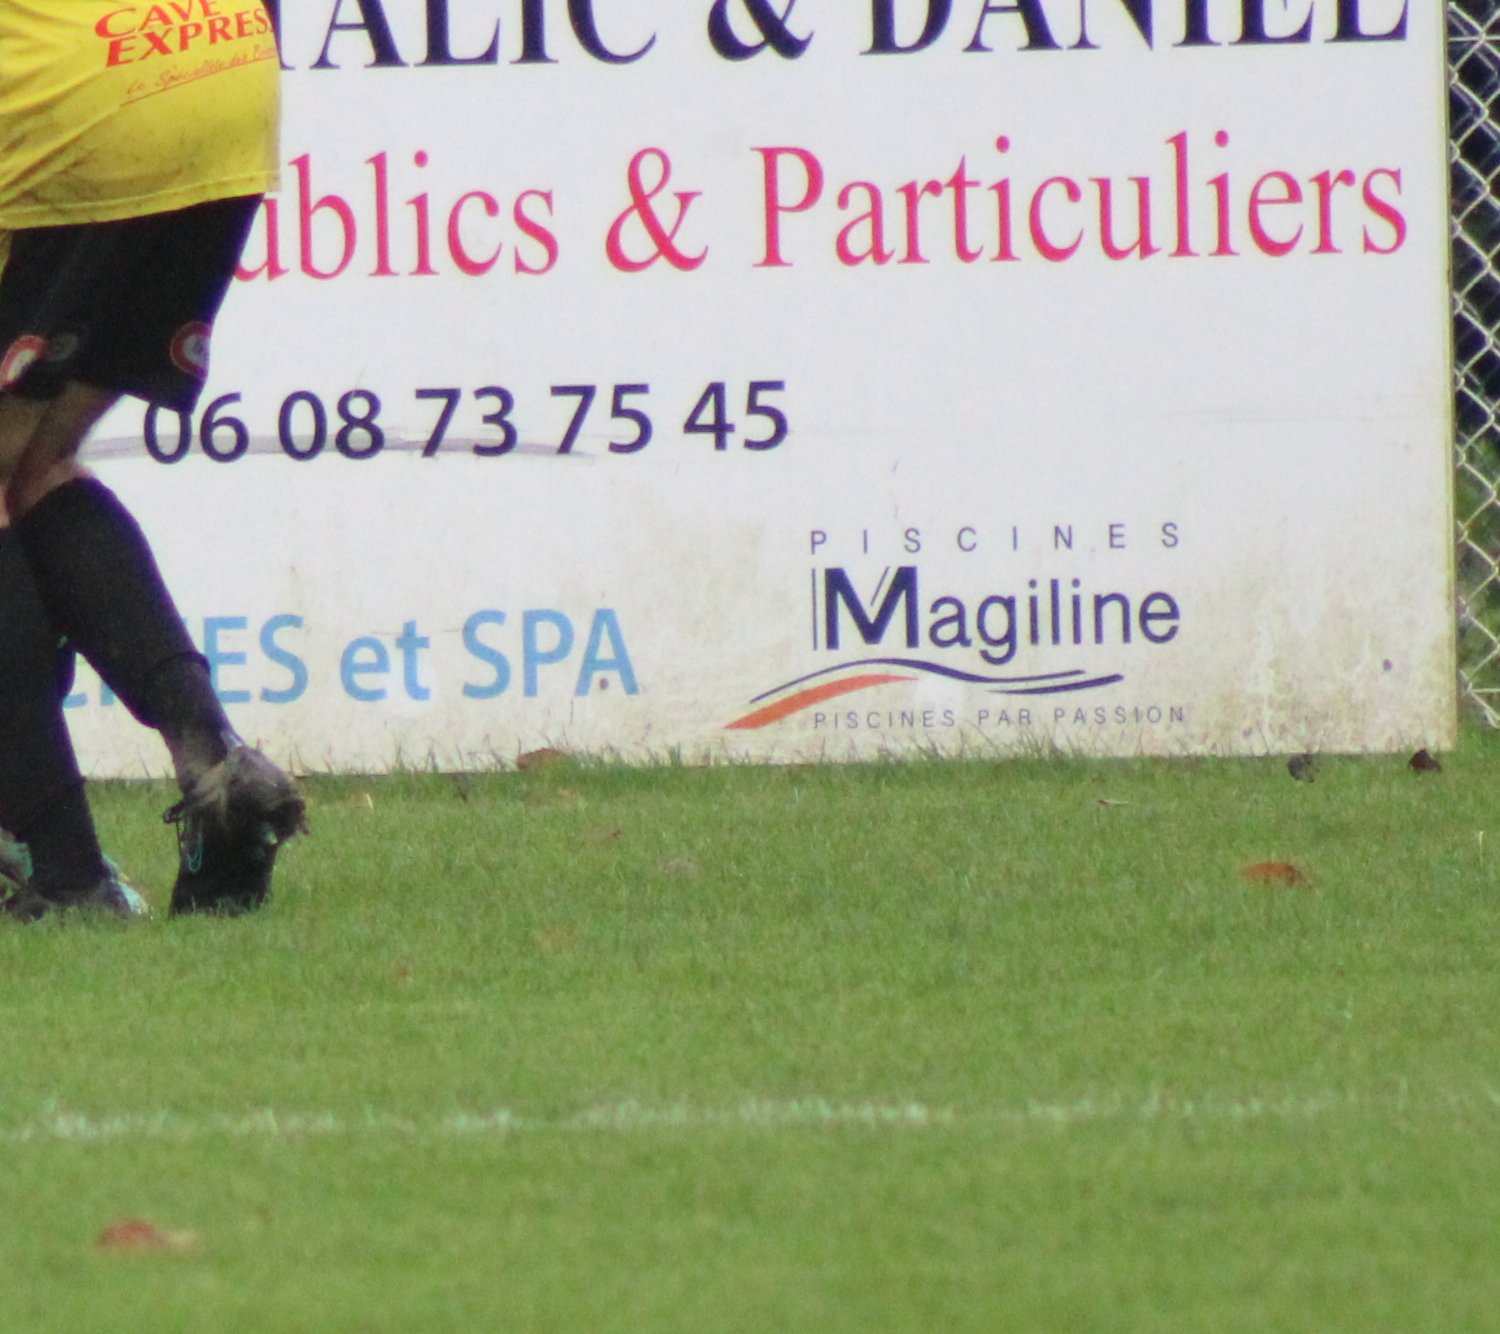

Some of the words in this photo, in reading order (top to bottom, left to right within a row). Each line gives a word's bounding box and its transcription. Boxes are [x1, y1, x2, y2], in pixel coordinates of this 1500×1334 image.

[105, 8, 275, 68] EXPRES
[234, 150, 559, 283] ublics
[604, 146, 709, 272] &
[752, 130, 1408, 268] Particuliers
[143, 392, 250, 464] 06
[278, 389, 385, 461] 08
[415, 386, 518, 458] 73
[550, 384, 653, 455] 75
[683, 380, 789, 451] 45
[809, 522, 1180, 555] PISCINES
[341, 620, 431, 702] et
[463, 608, 640, 699] SPA
[811, 565, 1180, 665] Magiline
[814, 710, 955, 729] PISCINES
[978, 709, 1032, 726] PAR
[1054, 706, 1185, 724] PASSION
